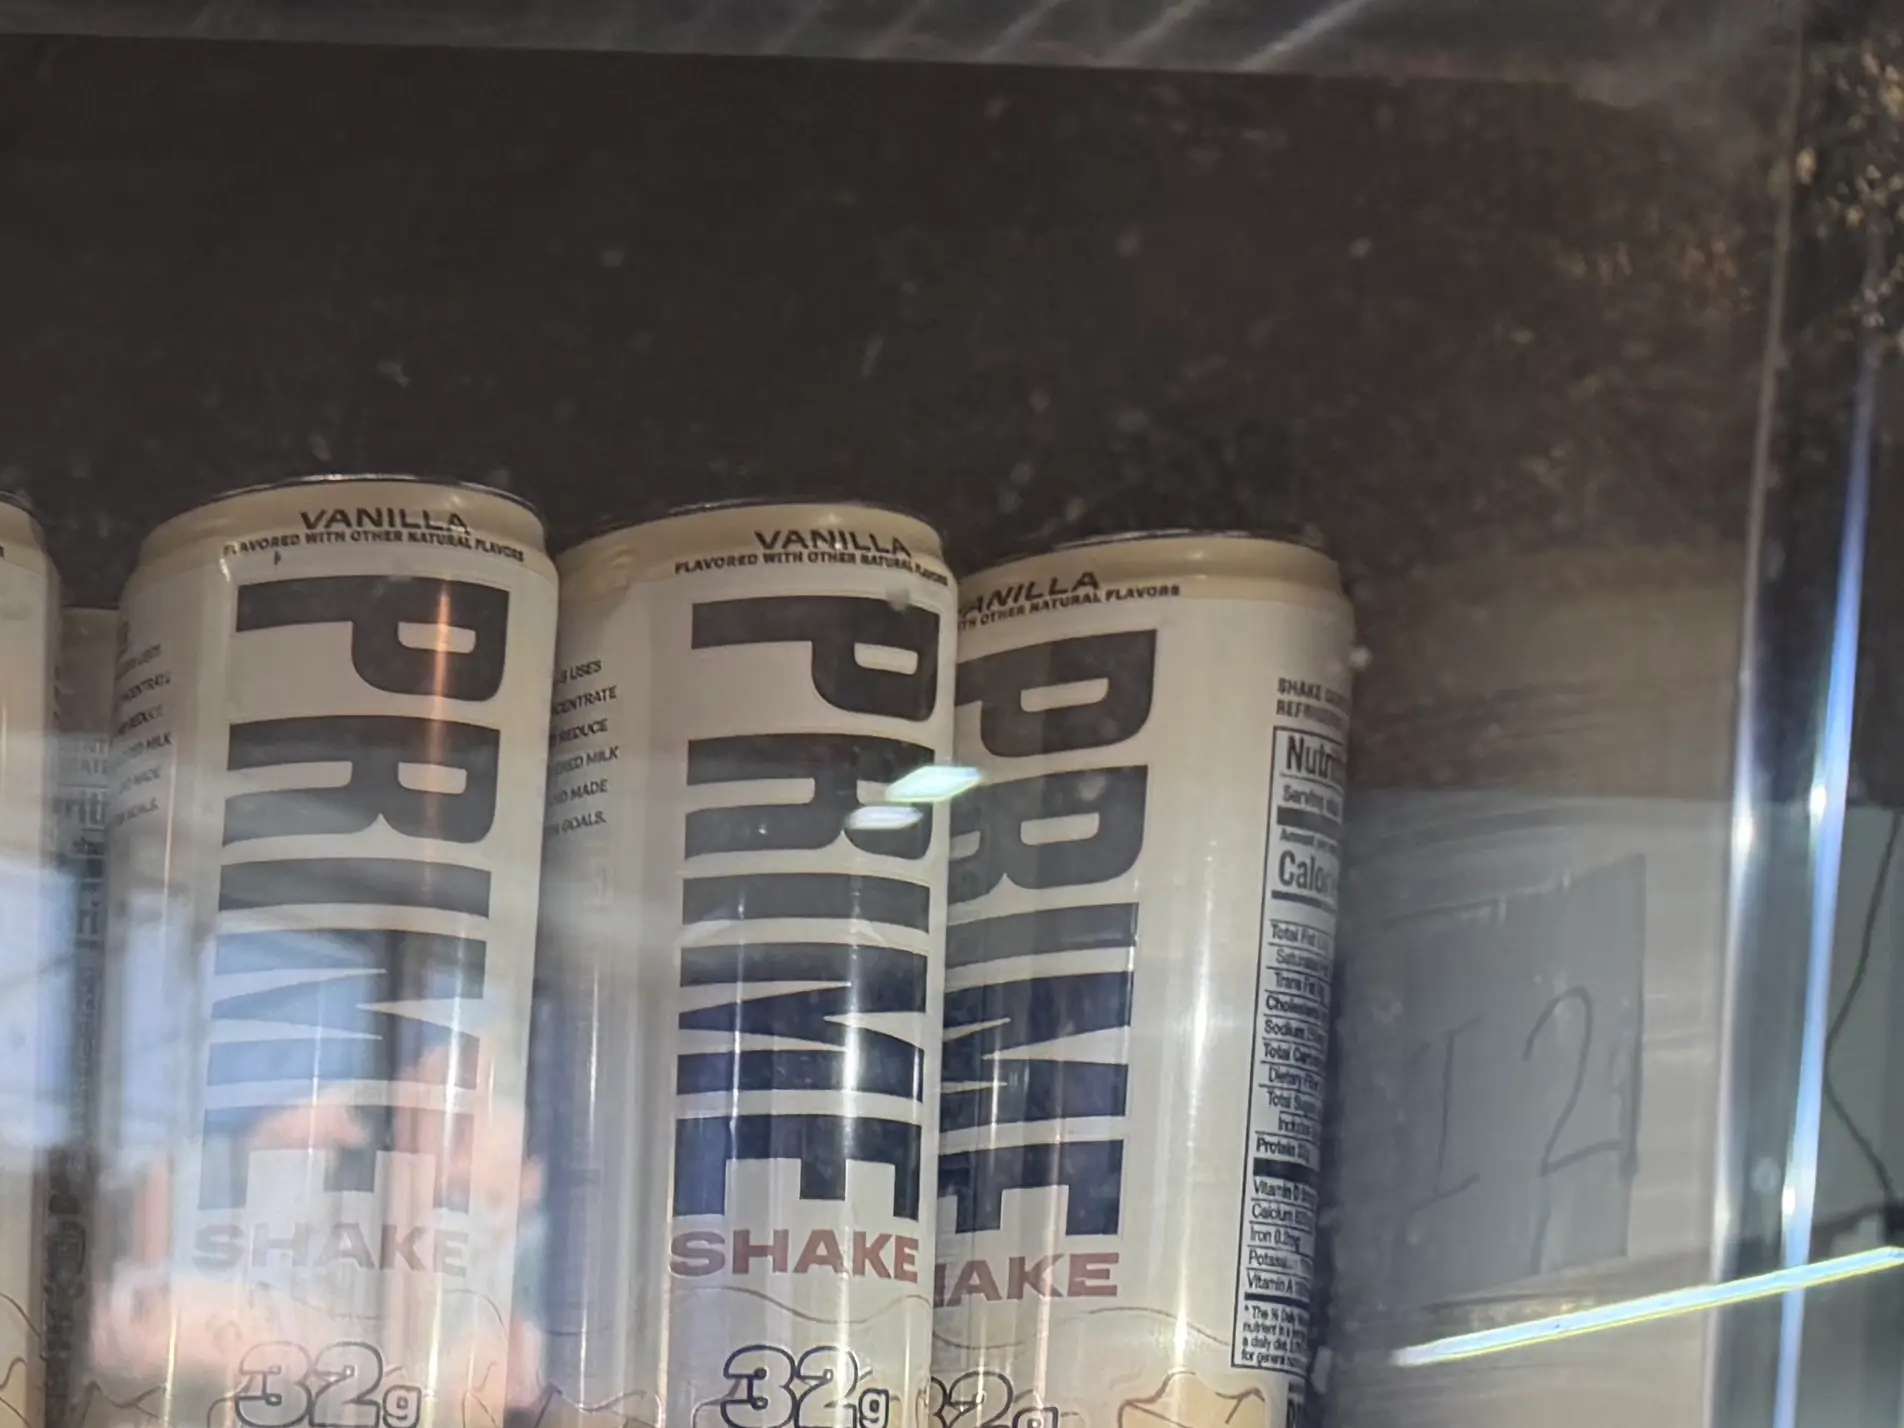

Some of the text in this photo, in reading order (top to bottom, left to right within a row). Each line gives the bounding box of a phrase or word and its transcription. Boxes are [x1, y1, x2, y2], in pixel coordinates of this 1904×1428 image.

[299, 506, 472, 535] VANILLA
[754, 527, 913, 558] VANILLA
[673, 594, 940, 1217] PRIME
[669, 1227, 920, 1284] SHAKE
